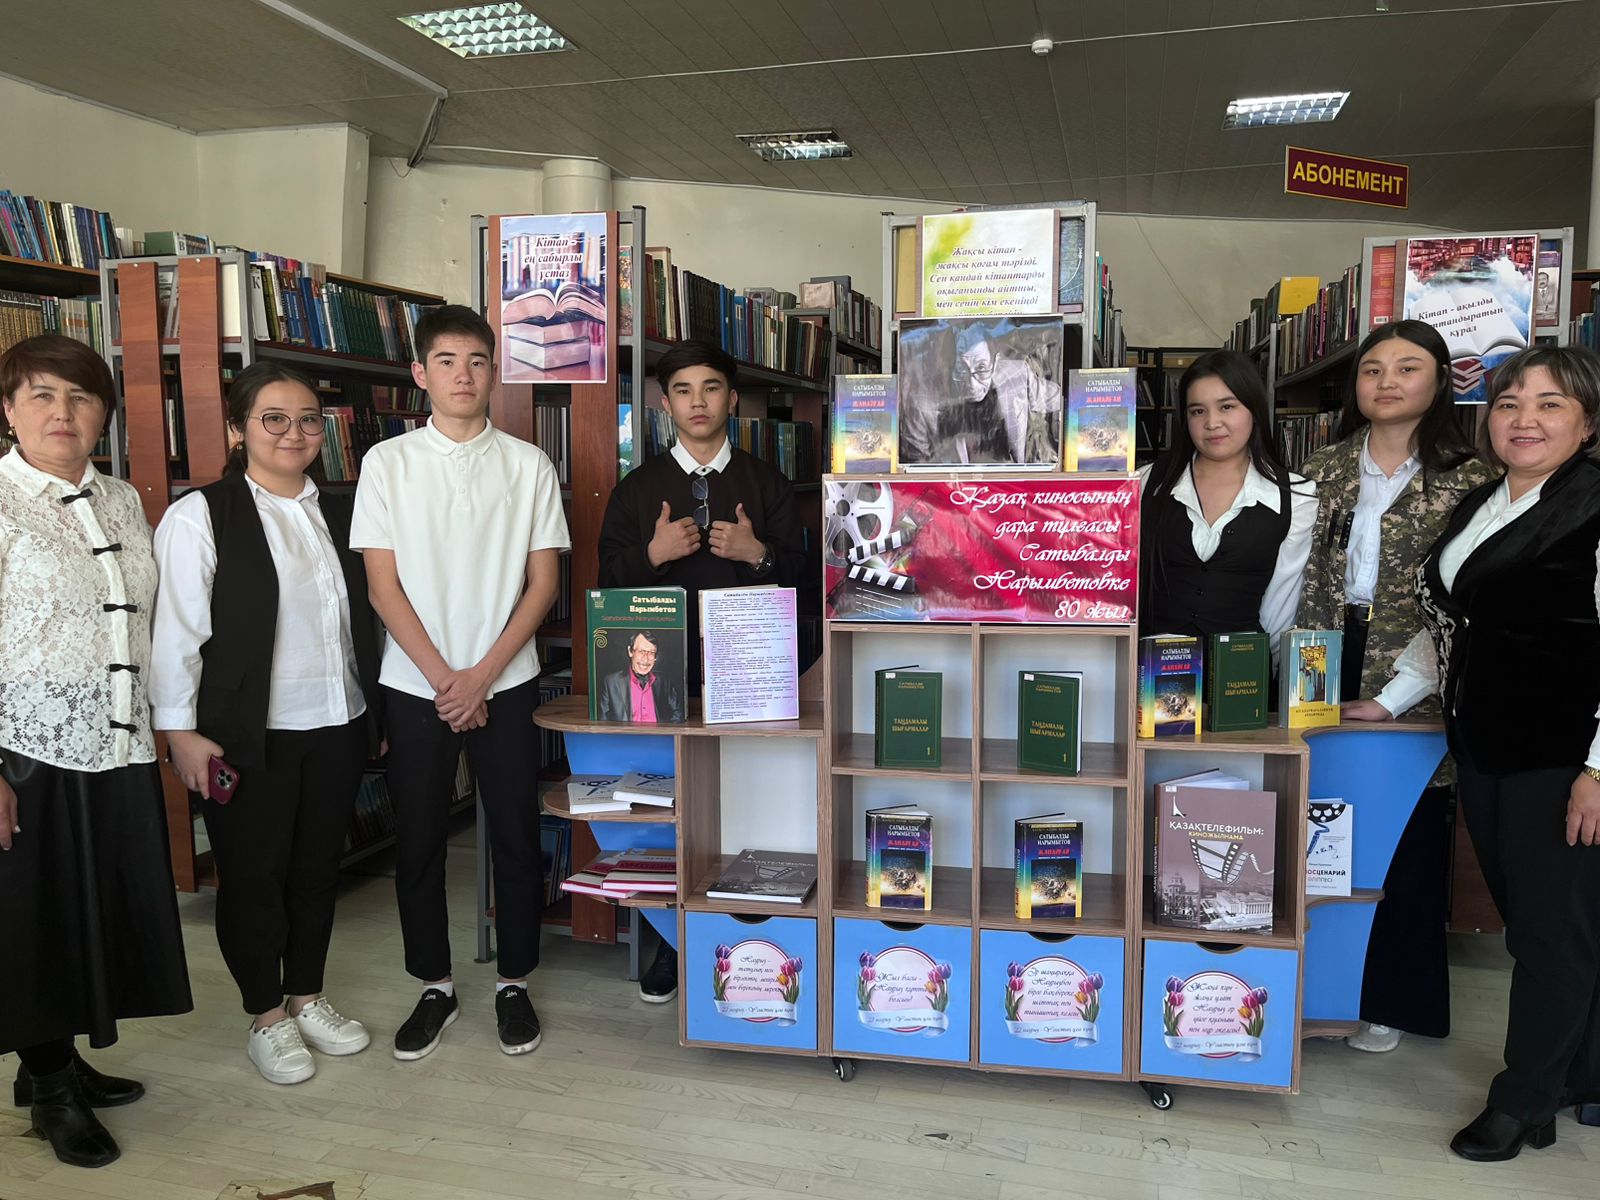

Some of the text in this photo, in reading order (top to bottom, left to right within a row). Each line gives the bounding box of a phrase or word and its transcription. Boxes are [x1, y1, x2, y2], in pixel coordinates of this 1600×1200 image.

[1292, 160, 1404, 195] АБОНЕМЕНТ
[536, 237, 569, 248] Кітап
[952, 247, 985, 257] Жақсы
[987, 245, 1016, 255] кітап
[537, 252, 582, 264] сабырлы
[936, 262, 969, 271] жақсы
[929, 271, 1045, 283] Сен қандай кітаптарды
[936, 300, 953, 309] мен
[981, 297, 997, 306] кім
[1418, 307, 1448, 320] Кітап
[1456, 297, 1494, 312] ақылды
[1449, 325, 1477, 338] құрал
[949, 486, 1132, 514] Қазақ киносының
[992, 519, 1038, 540] дара
[1041, 519, 1120, 539] тұлғасы
[1019, 543, 1131, 568] Сатыбалды
[973, 569, 1131, 596] Нарымбетовке
[632, 595, 677, 604] Сатыбалды
[629, 605, 677, 614] Нарымбетов
[1054, 600, 1129, 619] 80 жыл
[1169, 821, 1265, 836] ҚАЗАҚТЕЛЕФИЛЬМ:
[1188, 831, 1245, 841] КИНОЖЫЛНАМА
[1306, 868, 1347, 877] ОСЦЕНАРИЙ
